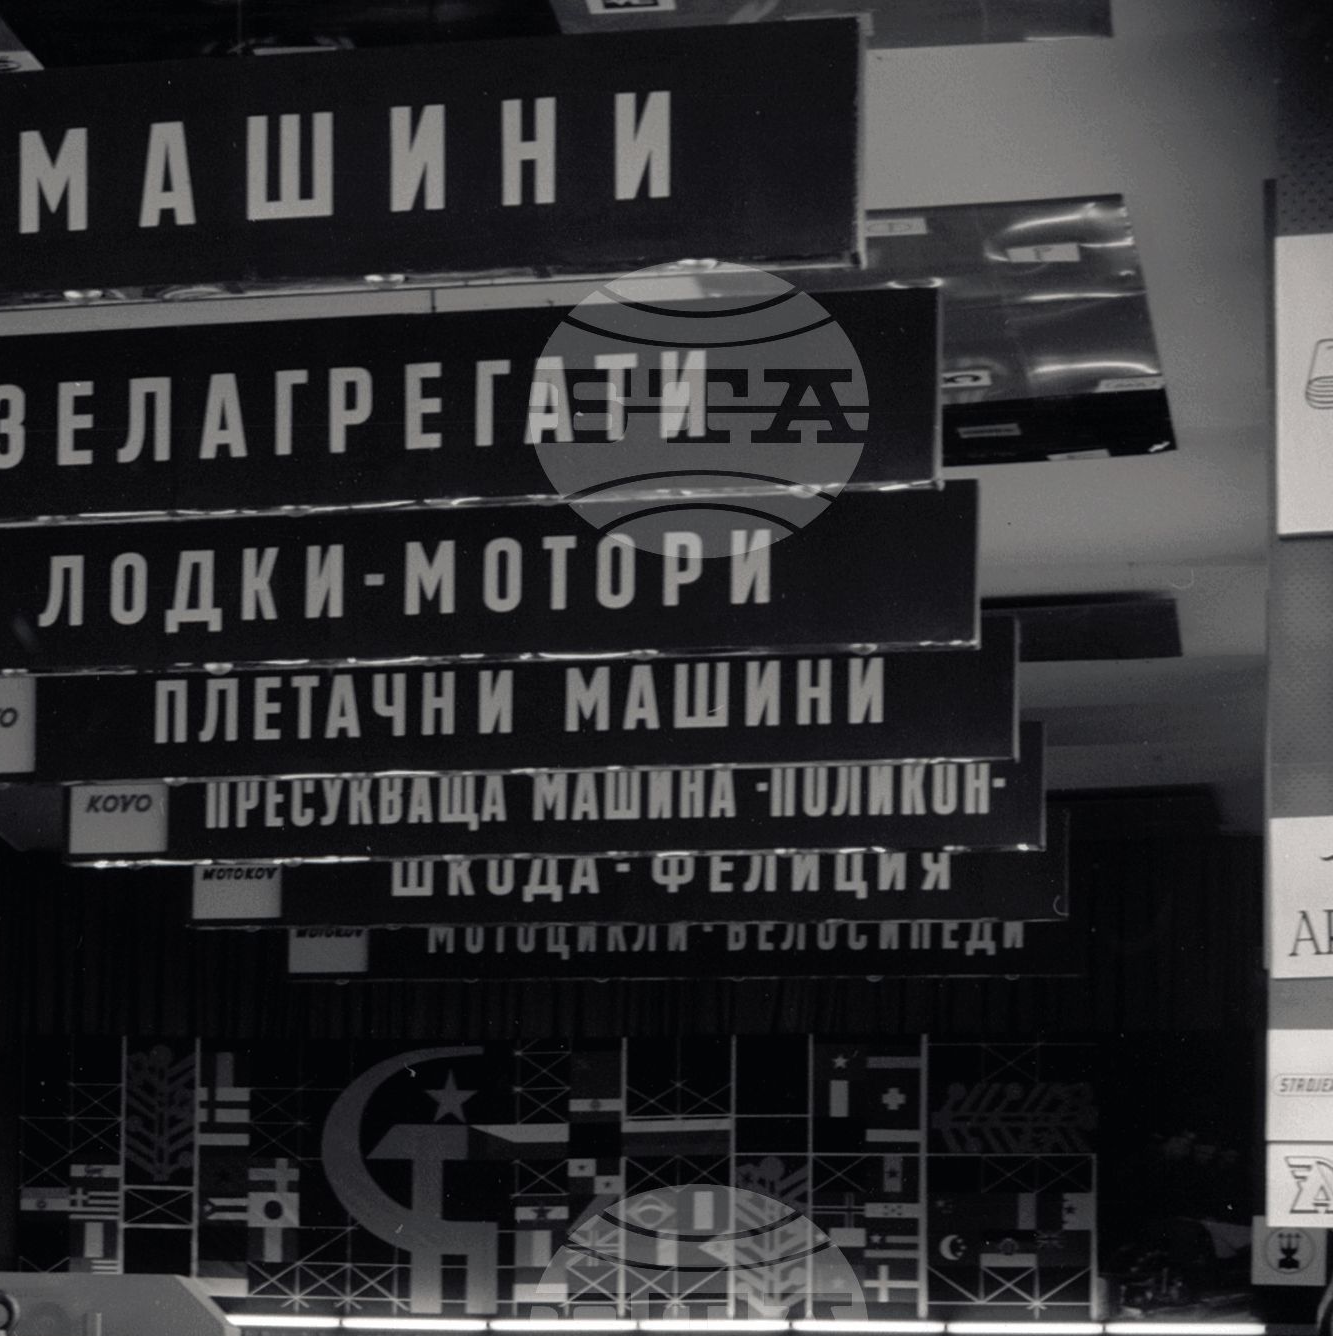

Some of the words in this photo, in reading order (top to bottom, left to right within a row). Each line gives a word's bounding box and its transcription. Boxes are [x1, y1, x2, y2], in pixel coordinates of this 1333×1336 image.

[38, 529, 773, 634] ЛОДКИ-МОТОРИ
[153, 668, 514, 745] ПЛЕТАЧНИ
[564, 657, 885, 733] МАШИНИ
[84, 792, 153, 815] KOVO
[204, 774, 507, 831] ПРЕСУКВАЩА
[533, 768, 738, 822] МАШИНА
[201, 866, 279, 881] MOTOKOV
